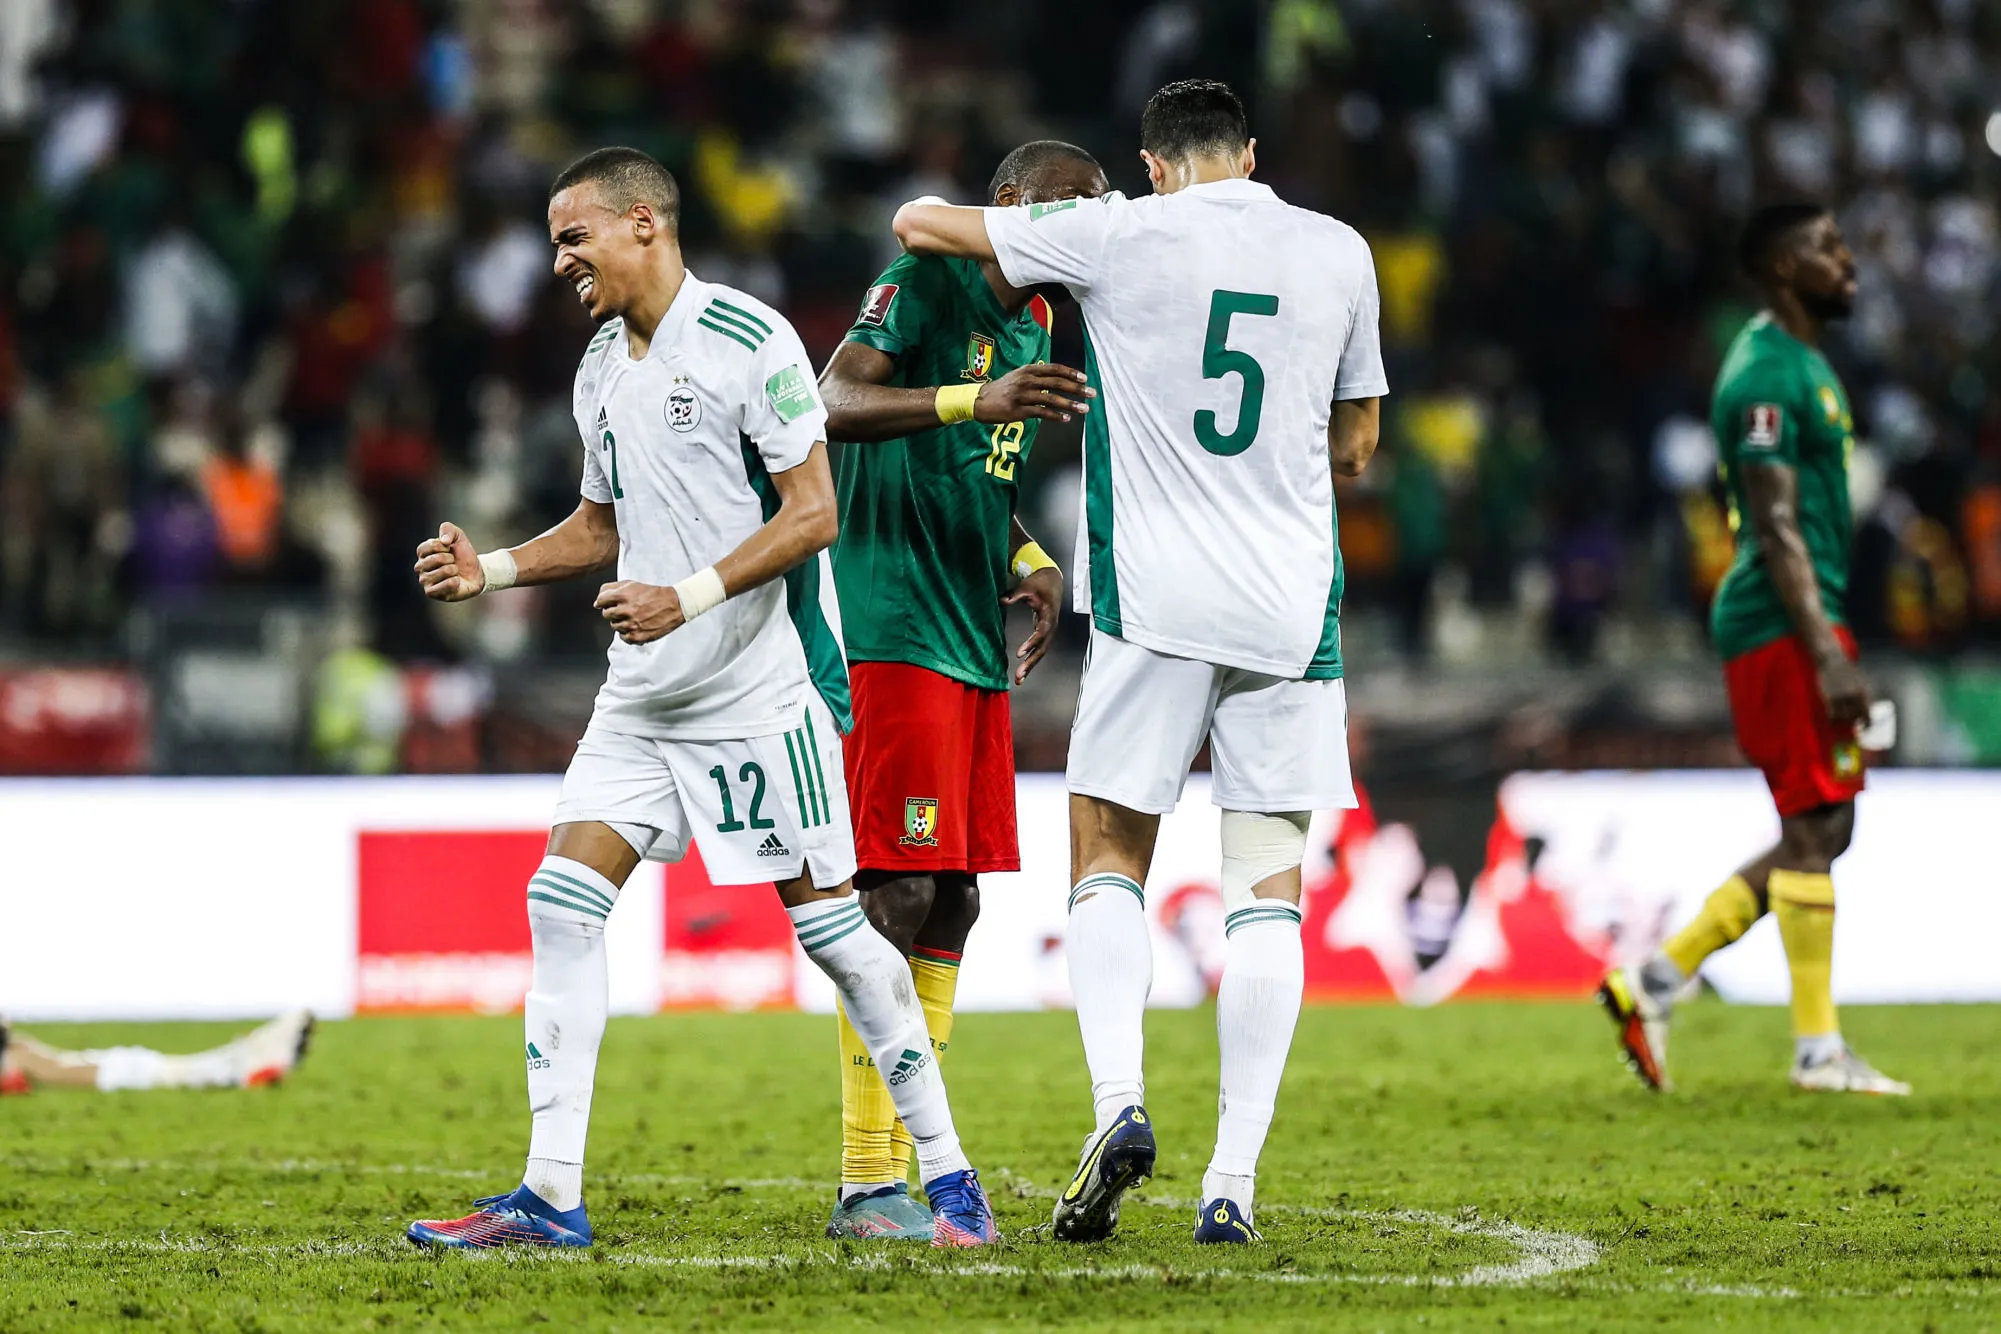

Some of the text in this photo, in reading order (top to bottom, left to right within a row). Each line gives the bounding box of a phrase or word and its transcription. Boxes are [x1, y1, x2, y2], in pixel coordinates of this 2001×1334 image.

[1193, 289, 1279, 457] 5
[985, 421, 1024, 481] 12
[709, 761, 775, 833] 12
[757, 848, 790, 857] adidas
[853, 1054, 864, 1066] LE
[889, 1053, 932, 1086] adidas
